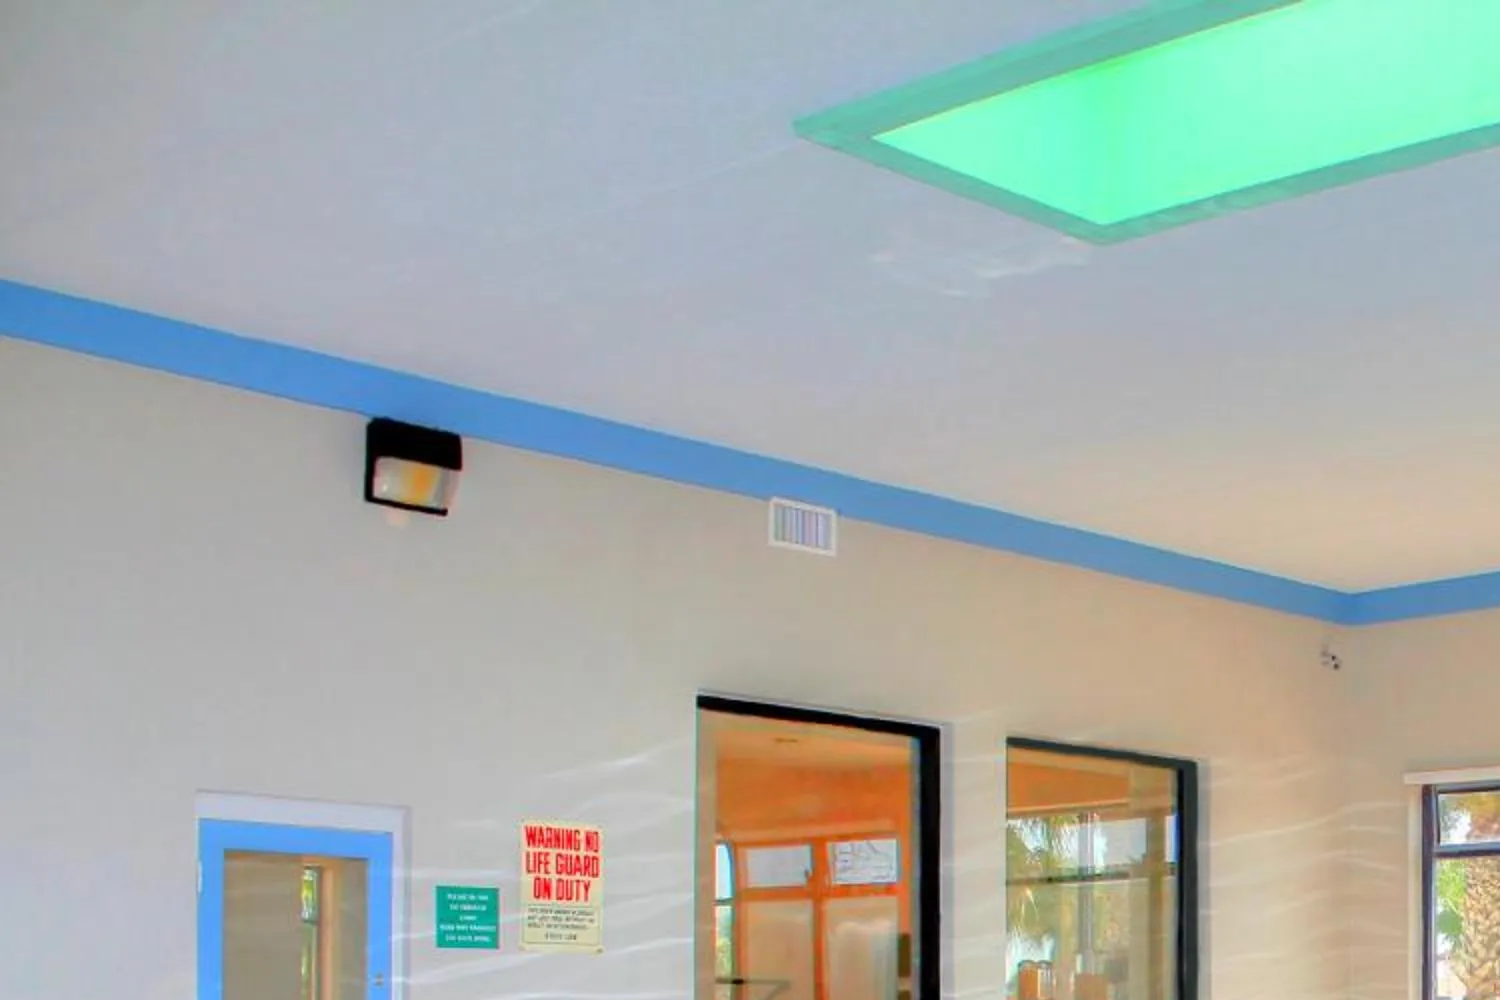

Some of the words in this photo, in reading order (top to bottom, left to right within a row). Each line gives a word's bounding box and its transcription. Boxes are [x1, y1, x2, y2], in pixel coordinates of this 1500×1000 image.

[525, 826, 581, 851] WARNING
[585, 831, 599, 852] NO
[526, 851, 550, 874] LIFE
[555, 853, 599, 878] GUARD
[534, 876, 552, 899] ON
[555, 878, 591, 902] DUTY
